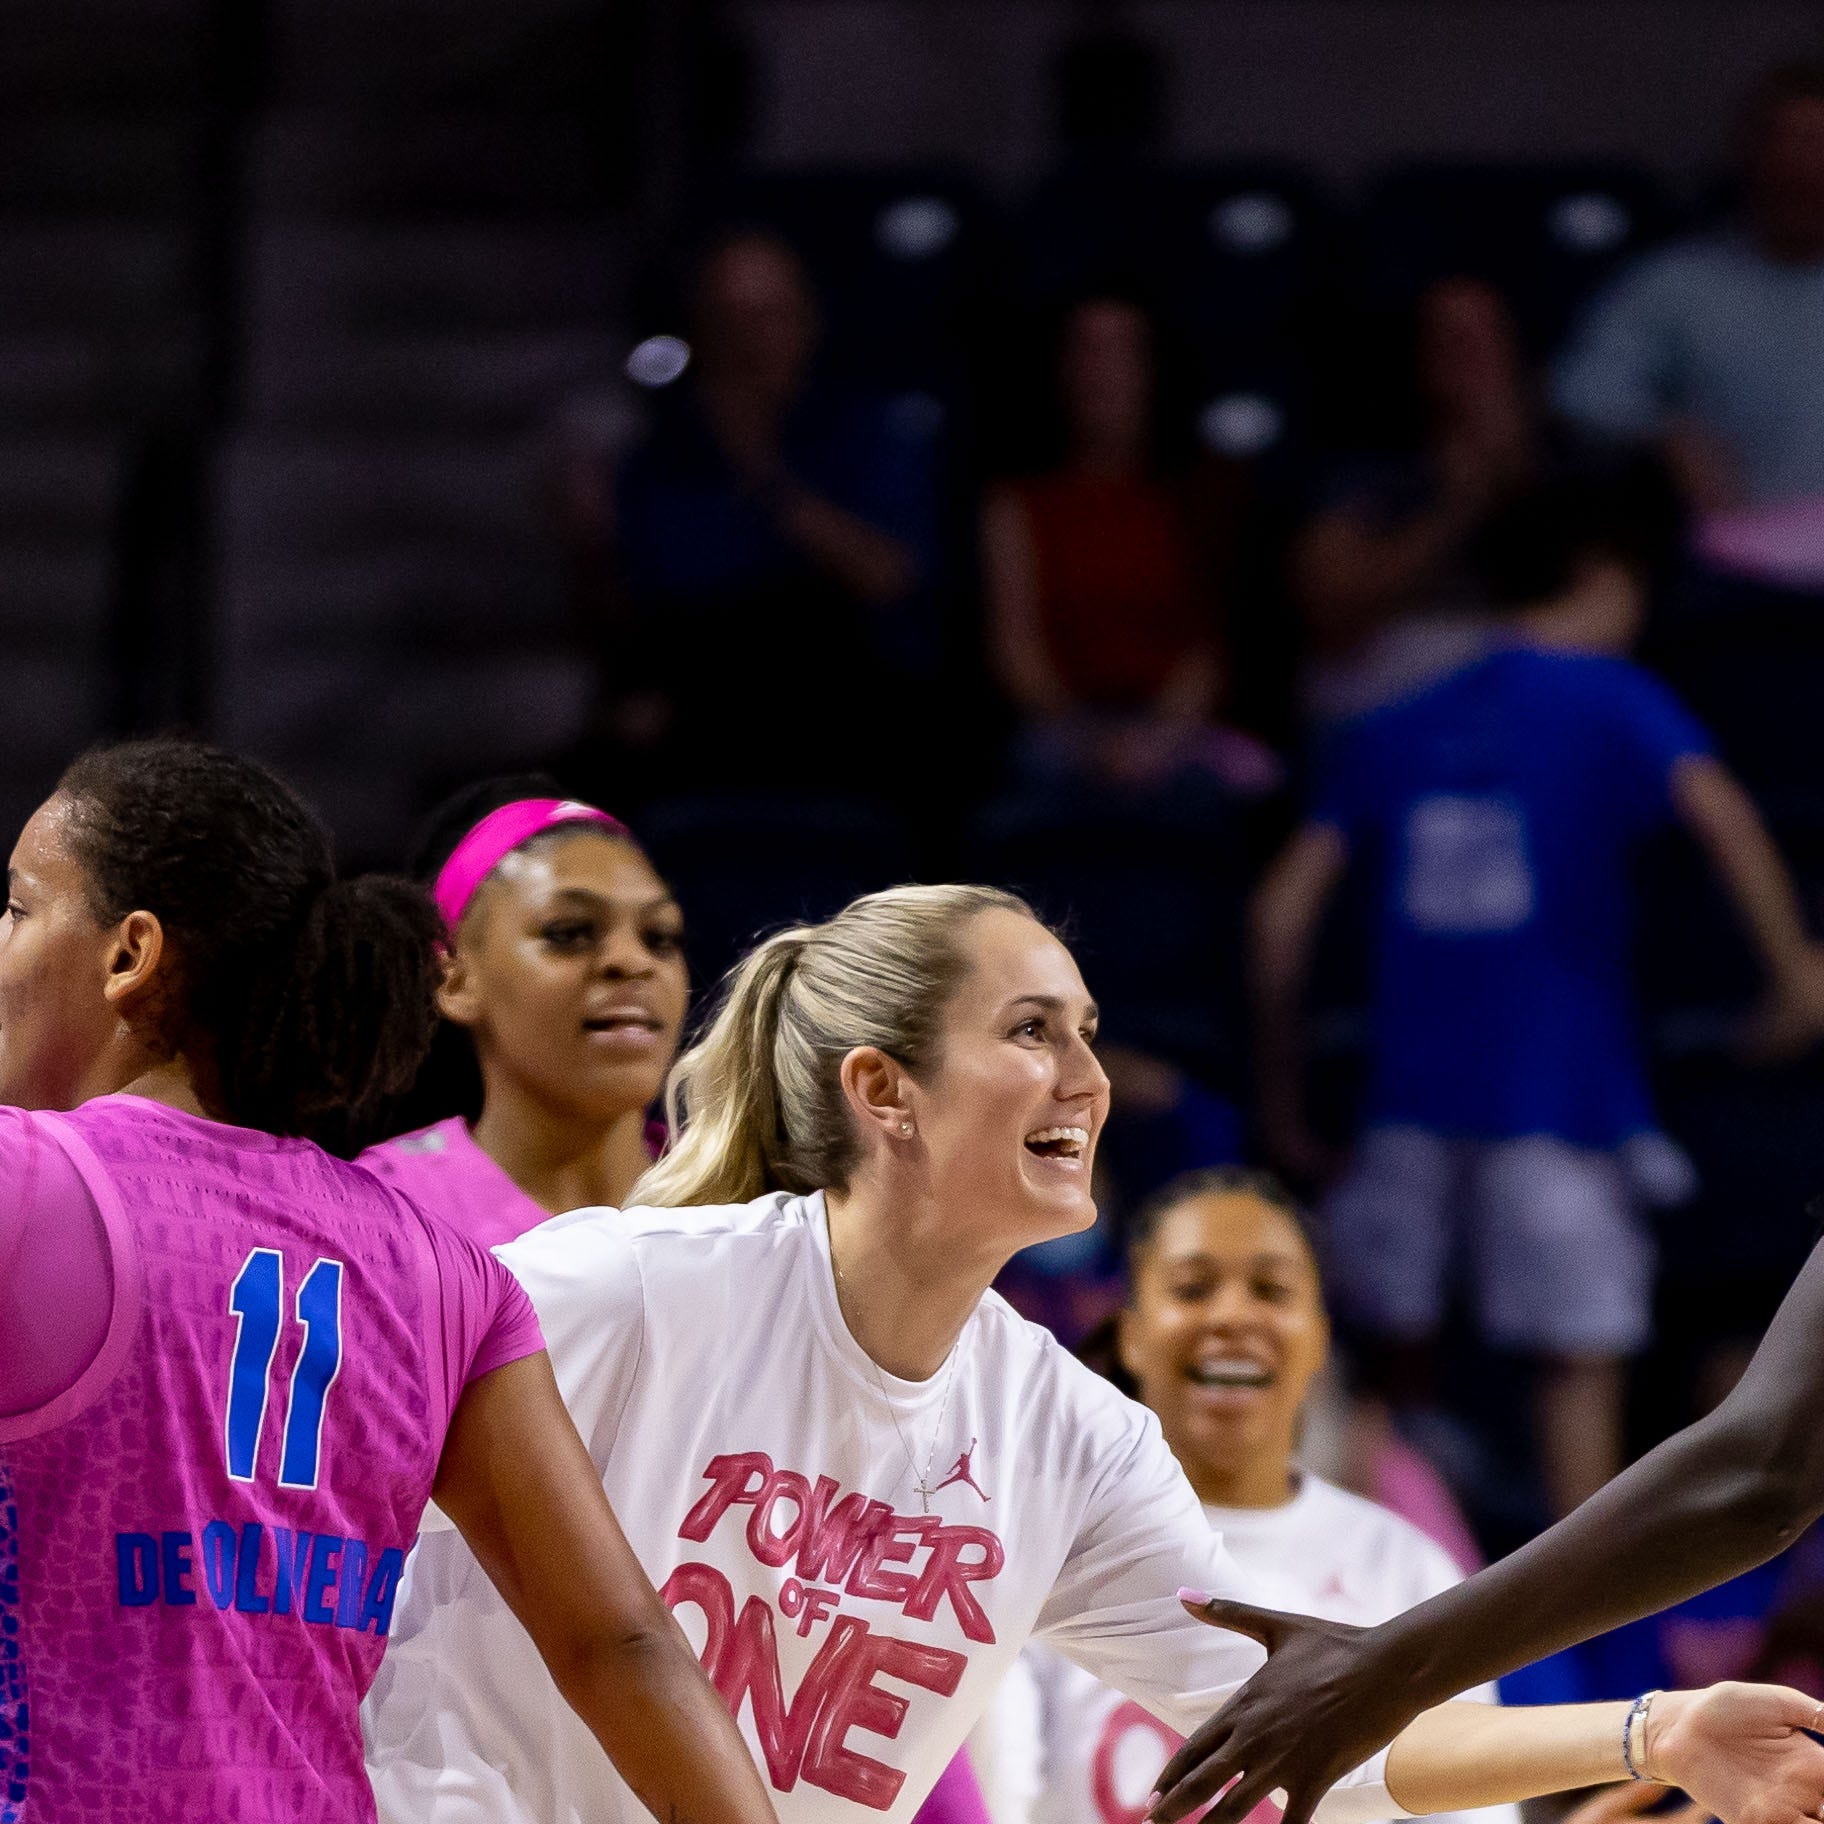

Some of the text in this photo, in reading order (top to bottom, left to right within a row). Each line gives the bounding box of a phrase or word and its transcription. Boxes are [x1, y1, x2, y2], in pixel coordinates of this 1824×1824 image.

[225, 1247, 343, 1490] 11
[116, 1531, 196, 1607] DE
[677, 1451, 1005, 1645] POWER
[778, 1577, 841, 1638] OF
